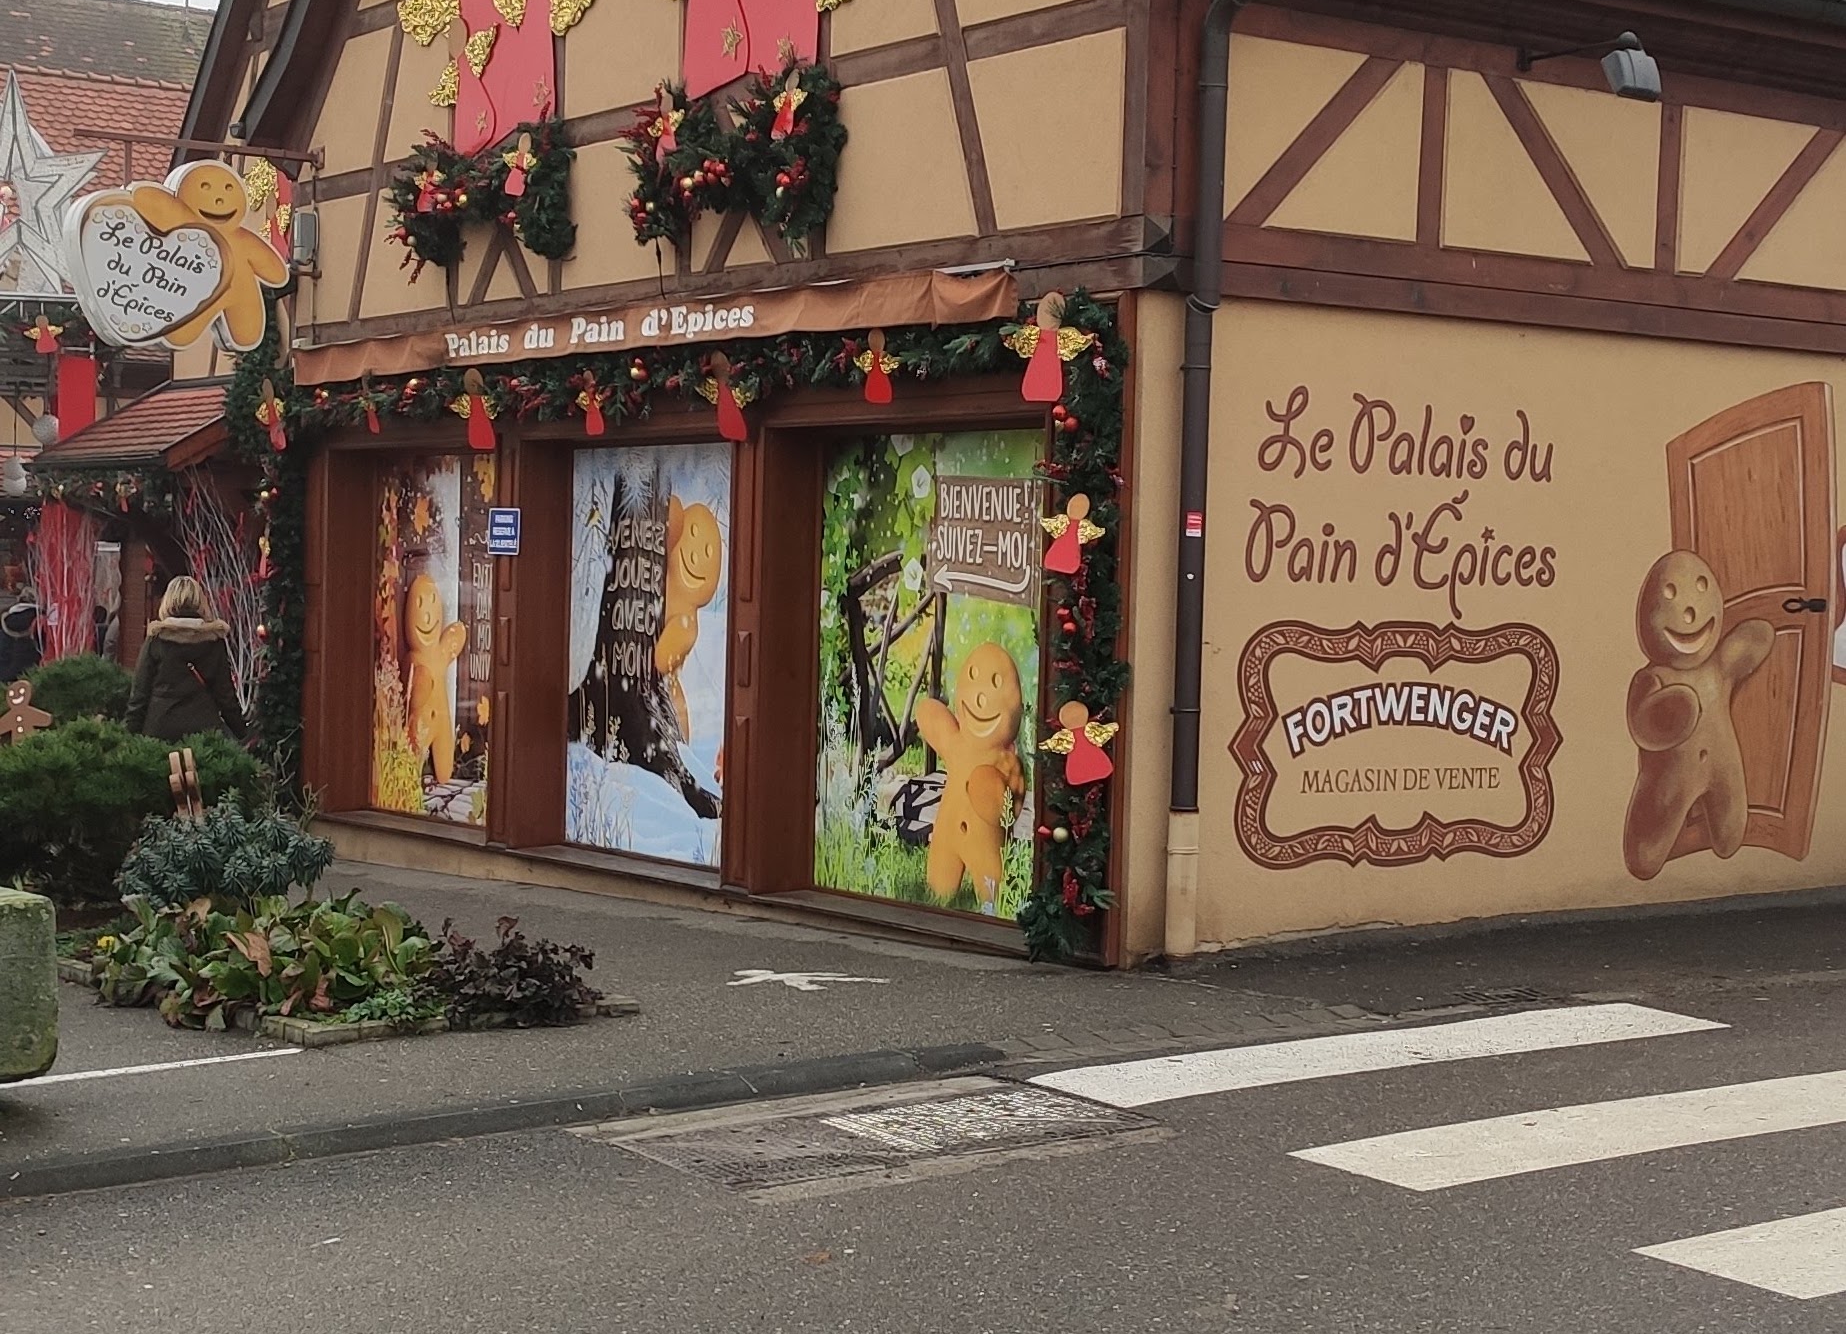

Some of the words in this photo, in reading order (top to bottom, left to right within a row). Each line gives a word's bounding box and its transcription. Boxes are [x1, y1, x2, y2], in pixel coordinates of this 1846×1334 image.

[99, 221, 135, 249] Le
[139, 231, 205, 274] Palais
[107, 252, 132, 276] du
[142, 262, 188, 297] Pain
[96, 279, 175, 323] d'Épices
[444, 329, 510, 358] Palais
[523, 323, 555, 349] du
[569, 316, 625, 344] Pain
[641, 304, 755, 338] d'Epices
[1258, 385, 1334, 479] Le
[1350, 392, 1489, 480] Palais
[1504, 409, 1554, 483] du
[610, 518, 666, 556] VENEZ
[1245, 498, 1357, 584] Pain
[1375, 489, 1557, 620] d'Épices
[607, 556, 662, 596] JOUER
[1284, 684, 1517, 756] FORTWENGER
[1300, 769, 1397, 794] MAGASIN
[1402, 768, 1430, 791] DE
[1435, 766, 1501, 790] VENTE
